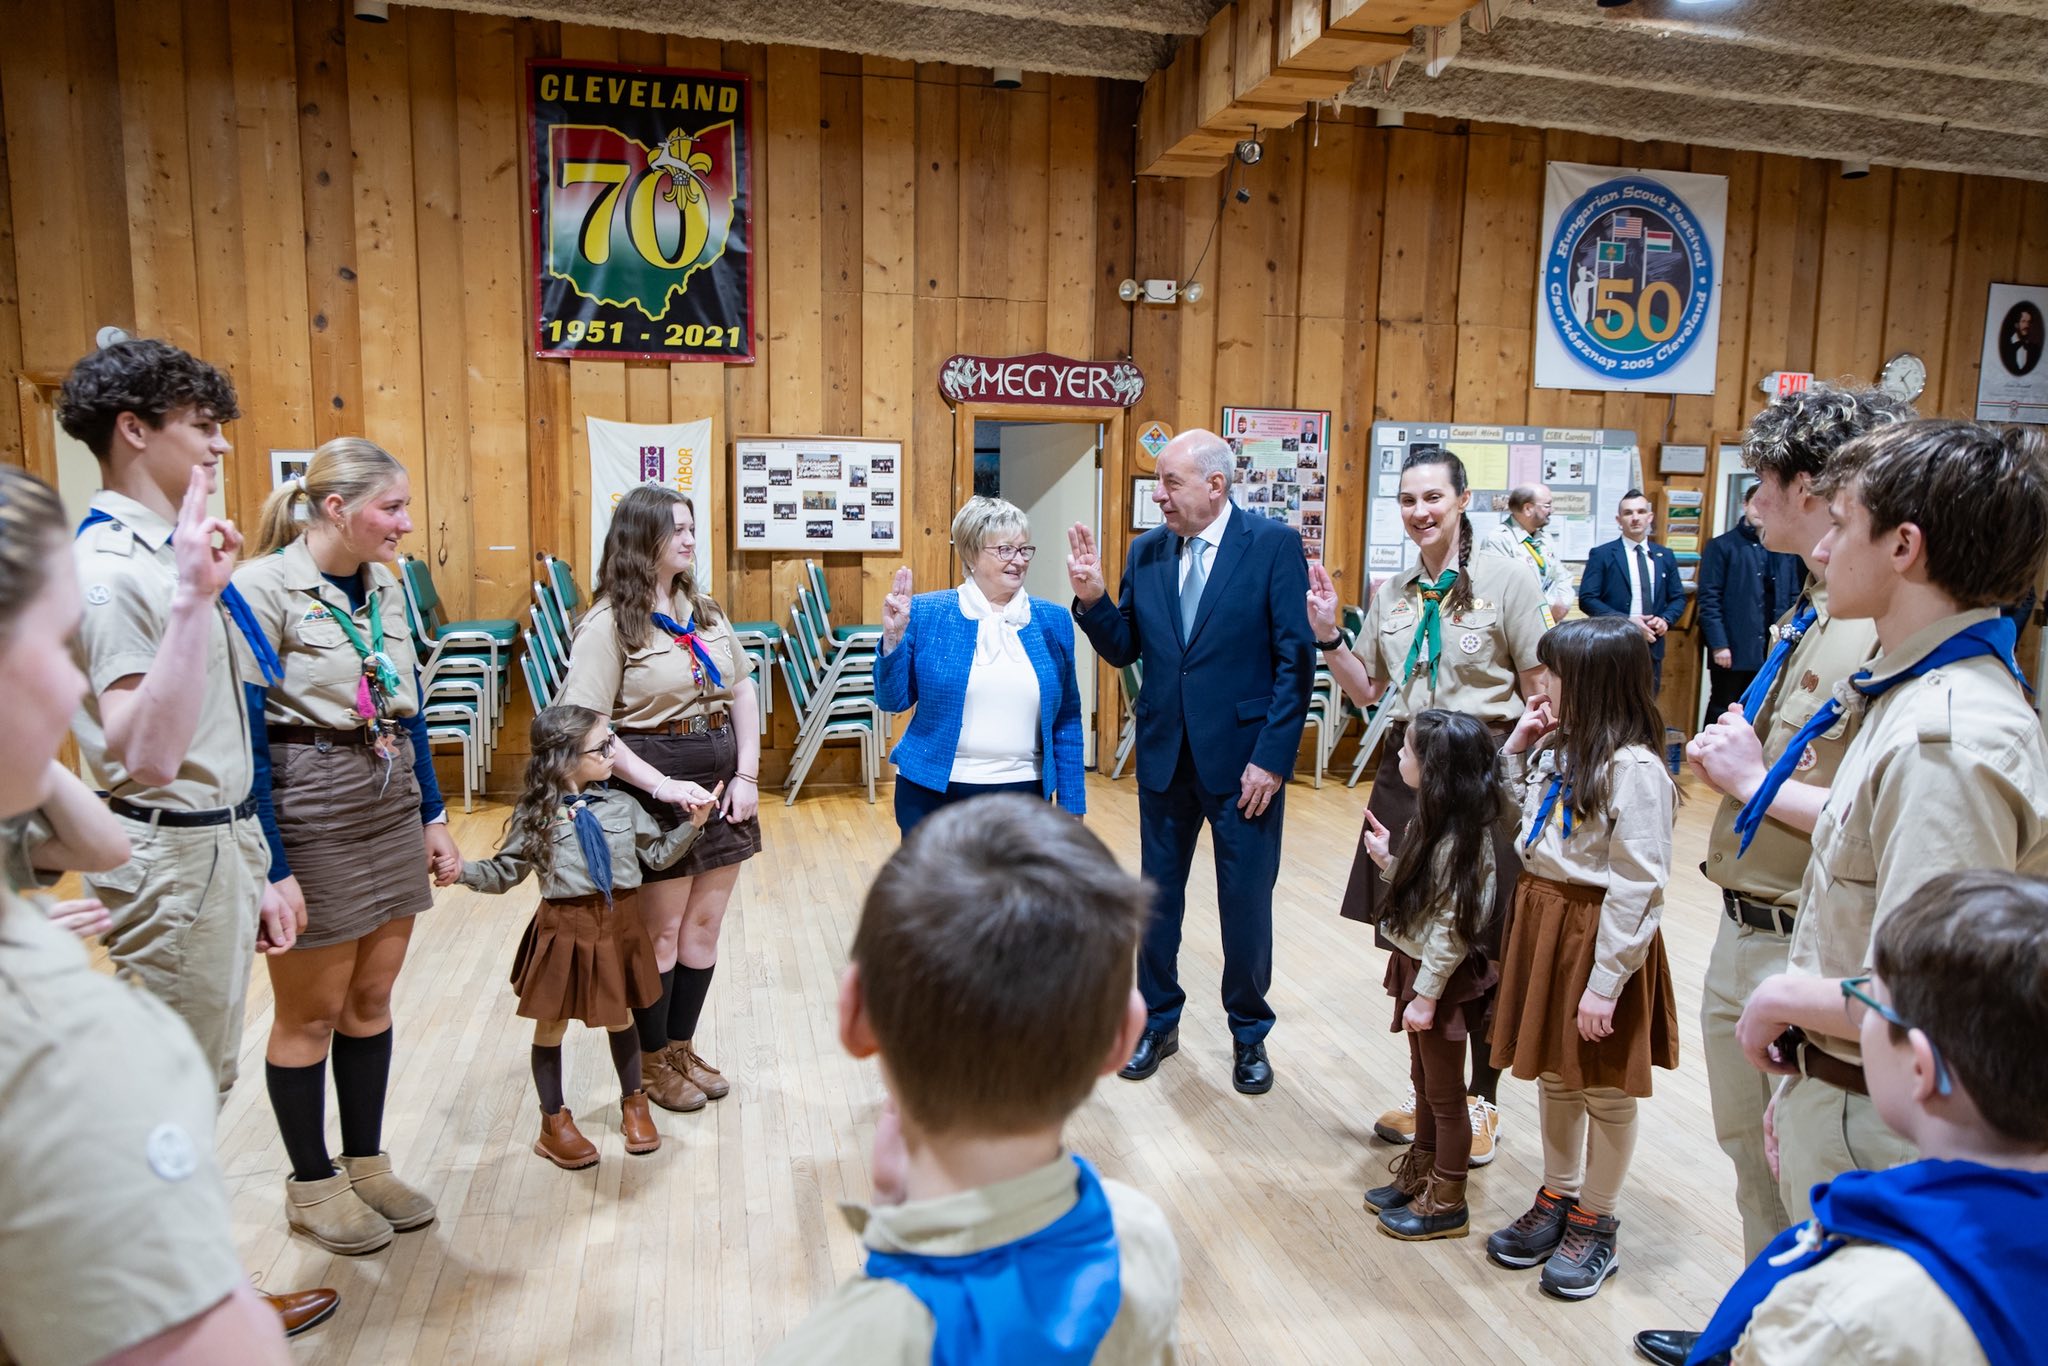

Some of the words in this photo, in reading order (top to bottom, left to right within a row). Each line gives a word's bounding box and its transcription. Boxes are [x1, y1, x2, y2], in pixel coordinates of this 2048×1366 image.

[540, 74, 738, 113] CLEVELAND
[558, 159, 711, 270] 70
[1556, 191, 1619, 259] Hungarian
[1622, 185, 1667, 207] Scout
[1667, 202, 1706, 268] Festival
[1551, 282, 1617, 370] Cserkésznap
[1620, 357, 1654, 370] 2005
[1656, 291, 1707, 361] Cleveland
[1593, 278, 1682, 342] 50
[549, 320, 624, 344] 1951
[664, 324, 740, 347] 2021
[979, 362, 1110, 399] MEGYER
[1779, 374, 1808, 397] EXIT
[673, 447, 693, 492] TÁBOR
